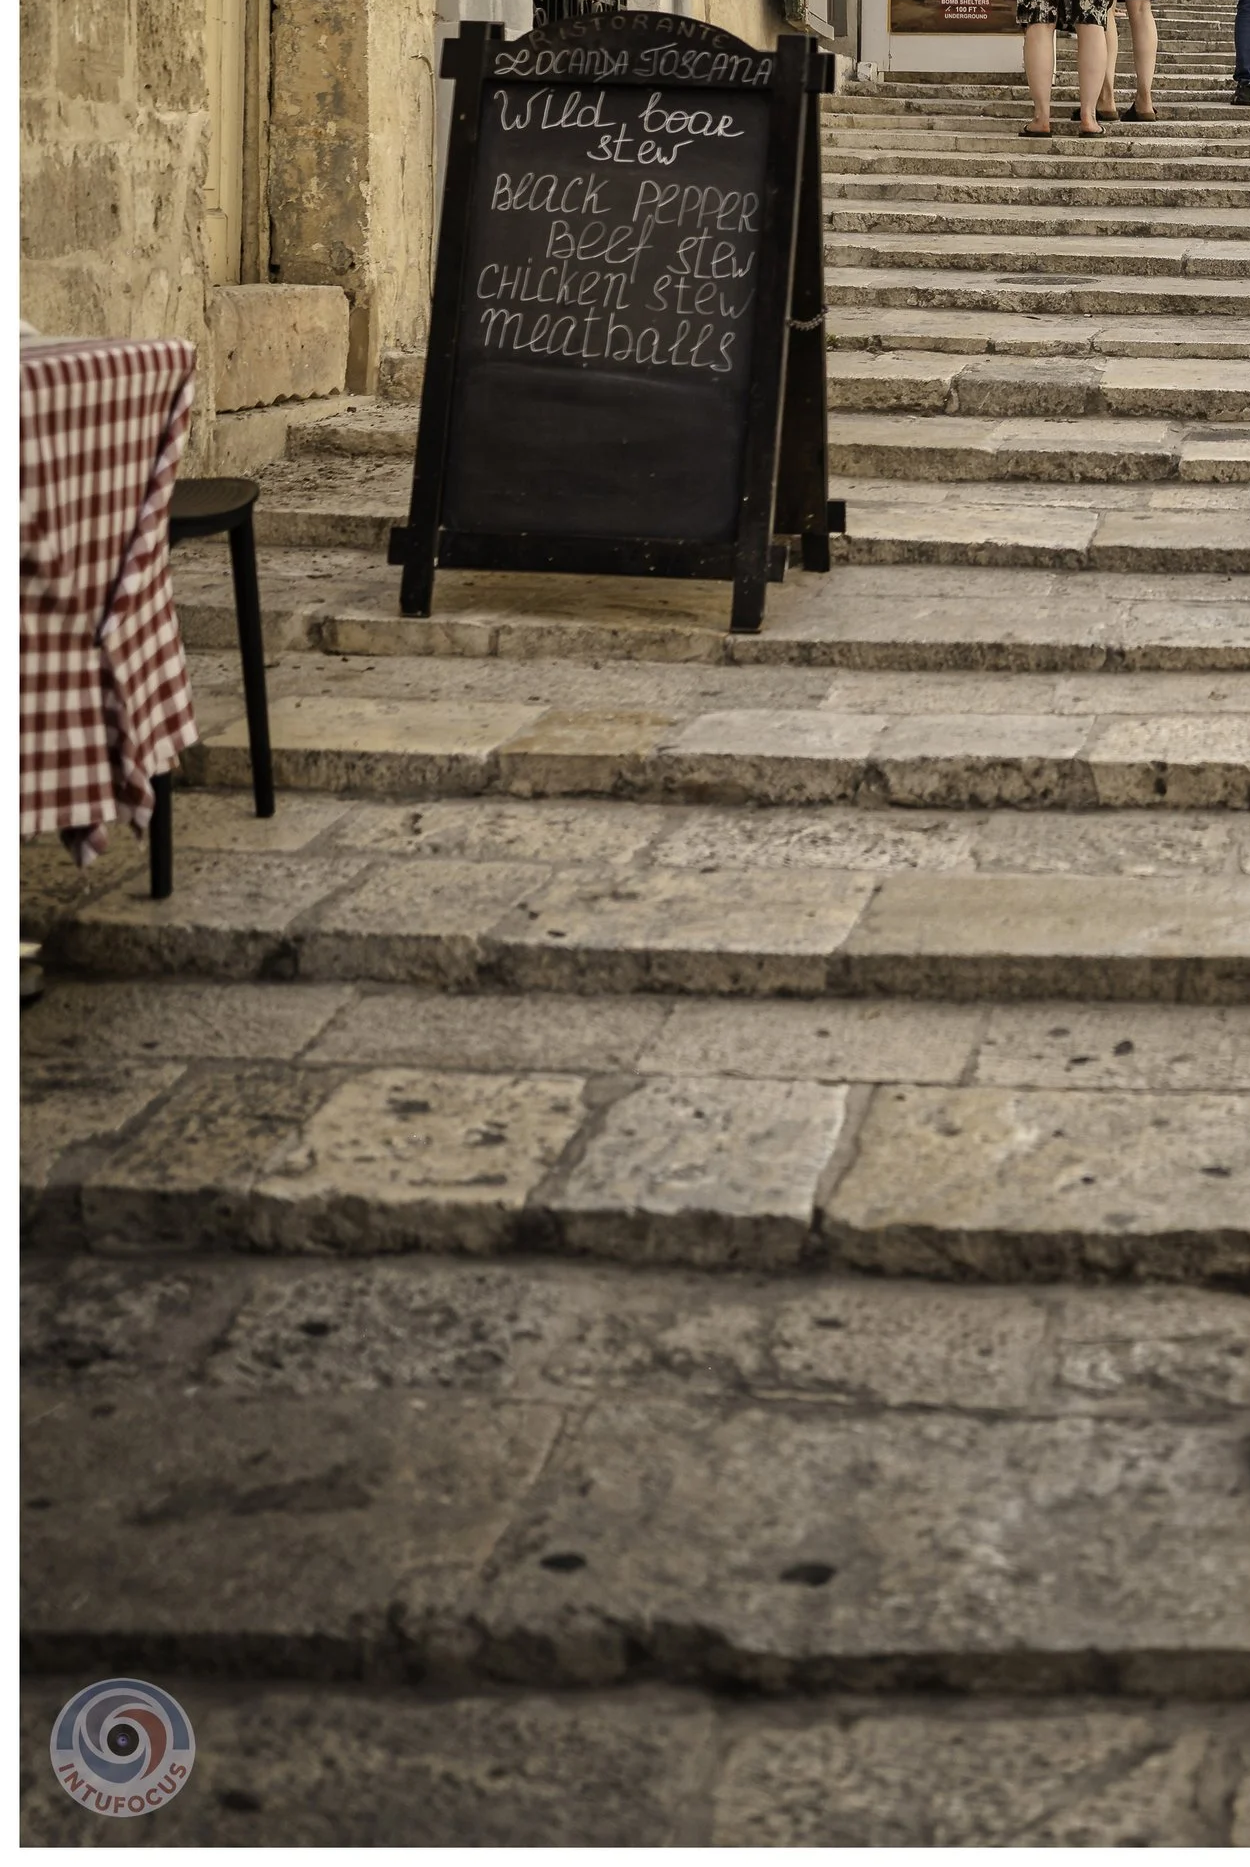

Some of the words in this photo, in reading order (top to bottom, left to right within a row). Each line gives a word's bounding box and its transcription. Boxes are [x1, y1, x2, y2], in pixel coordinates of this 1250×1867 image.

[528, 14, 730, 51] RISTORANTE
[634, 41, 775, 85] TOSCANA
[493, 87, 614, 131] Wild
[586, 122, 695, 166] stew
[545, 214, 656, 284] Beef
[666, 227, 756, 280] stew
[645, 274, 757, 320] stew
[479, 306, 737, 373] meatballs
